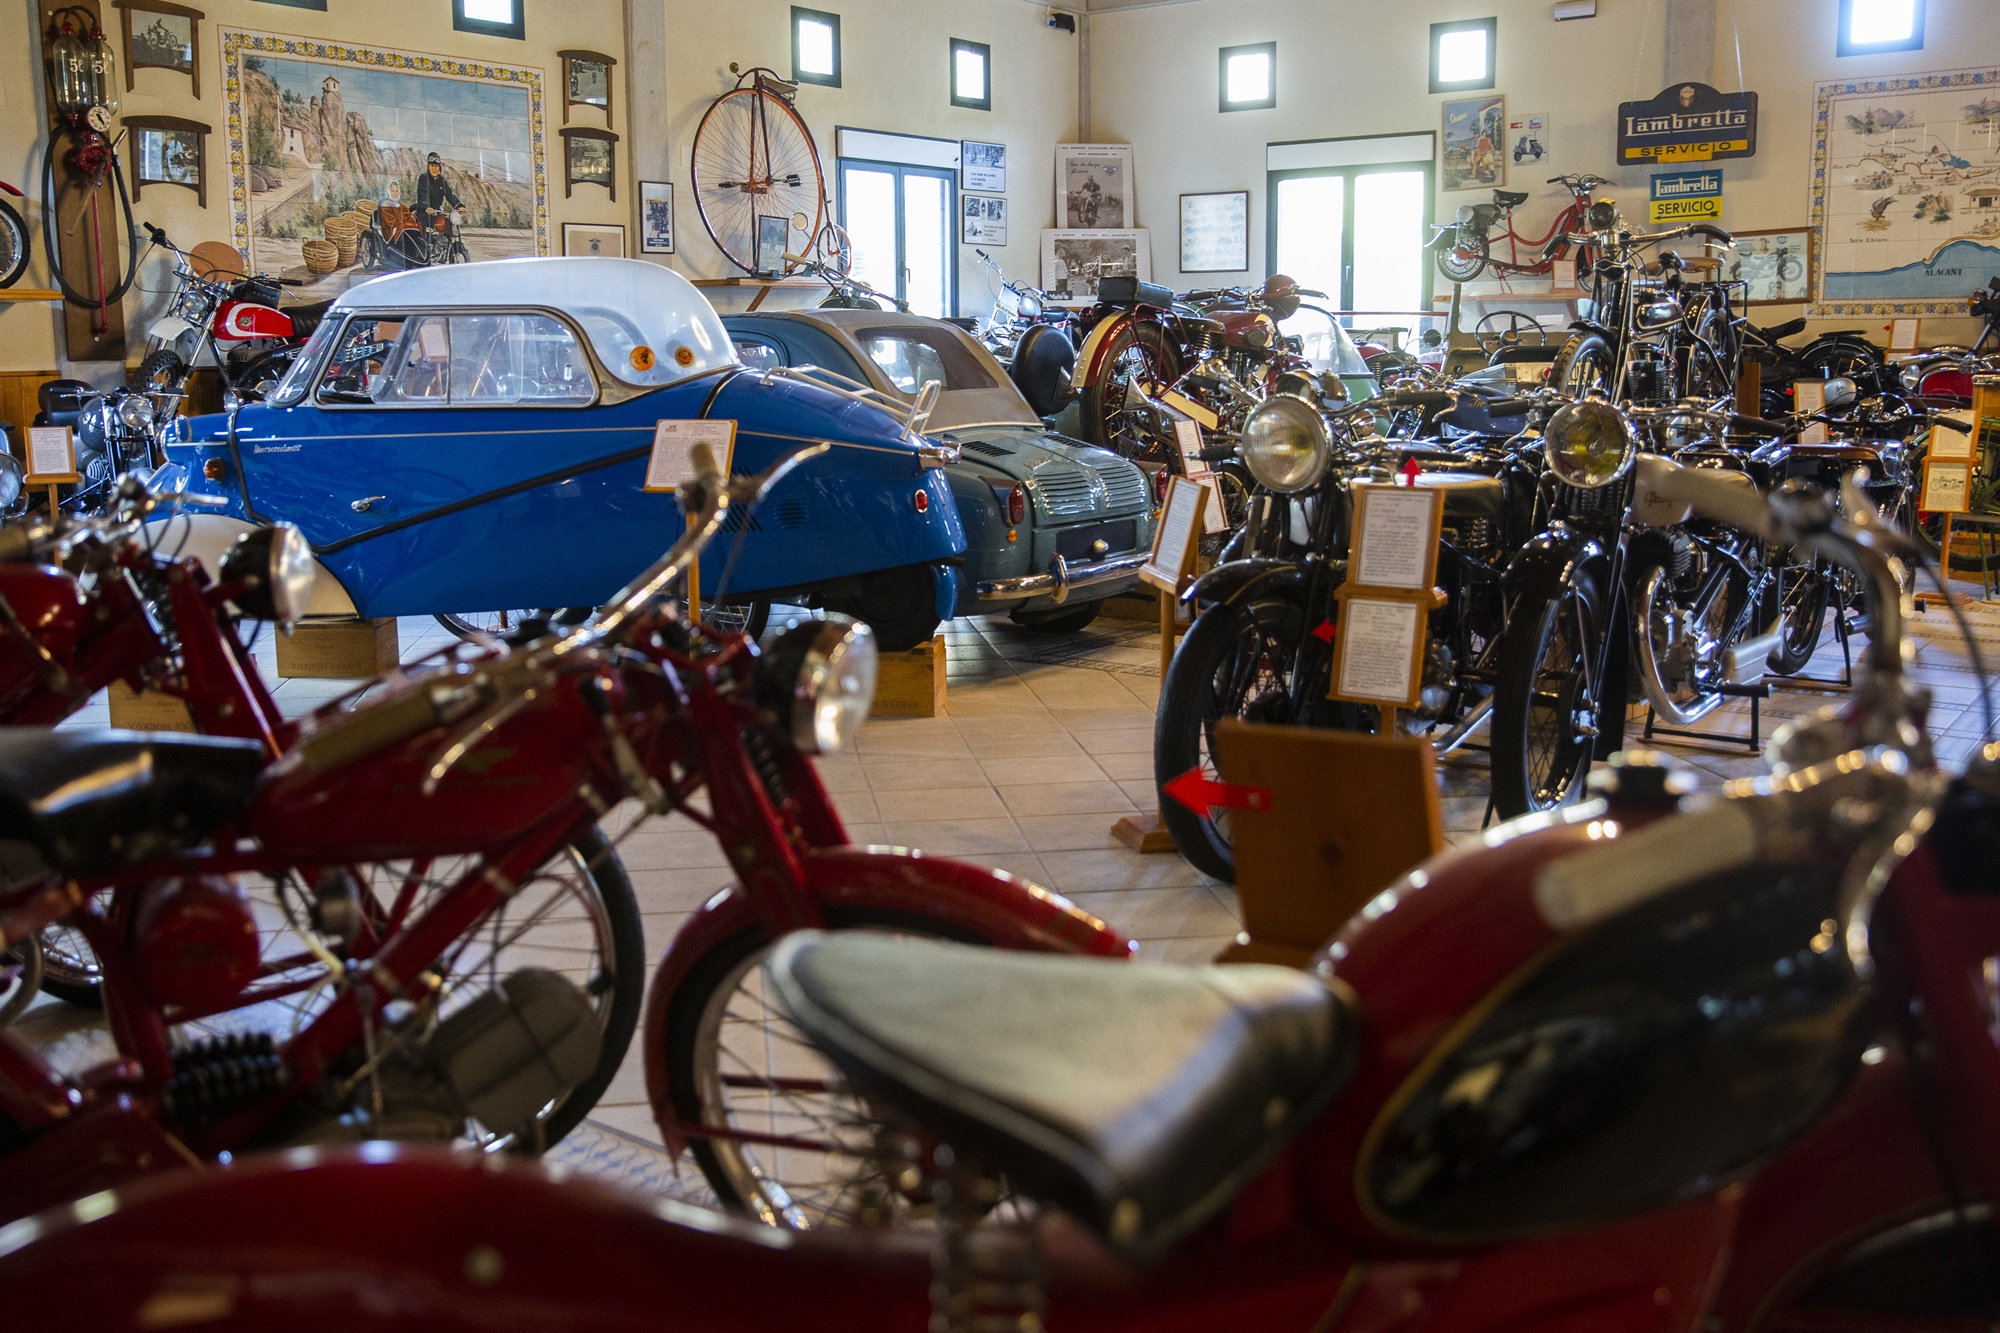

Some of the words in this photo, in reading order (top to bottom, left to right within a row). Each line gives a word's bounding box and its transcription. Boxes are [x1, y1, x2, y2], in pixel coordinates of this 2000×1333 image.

[1625, 109, 1748, 137] Lambretta
[1640, 141, 1732, 157] SERVICIO
[1655, 175, 1718, 197] Lambretta
[1657, 200, 1714, 215] SERVICIO
